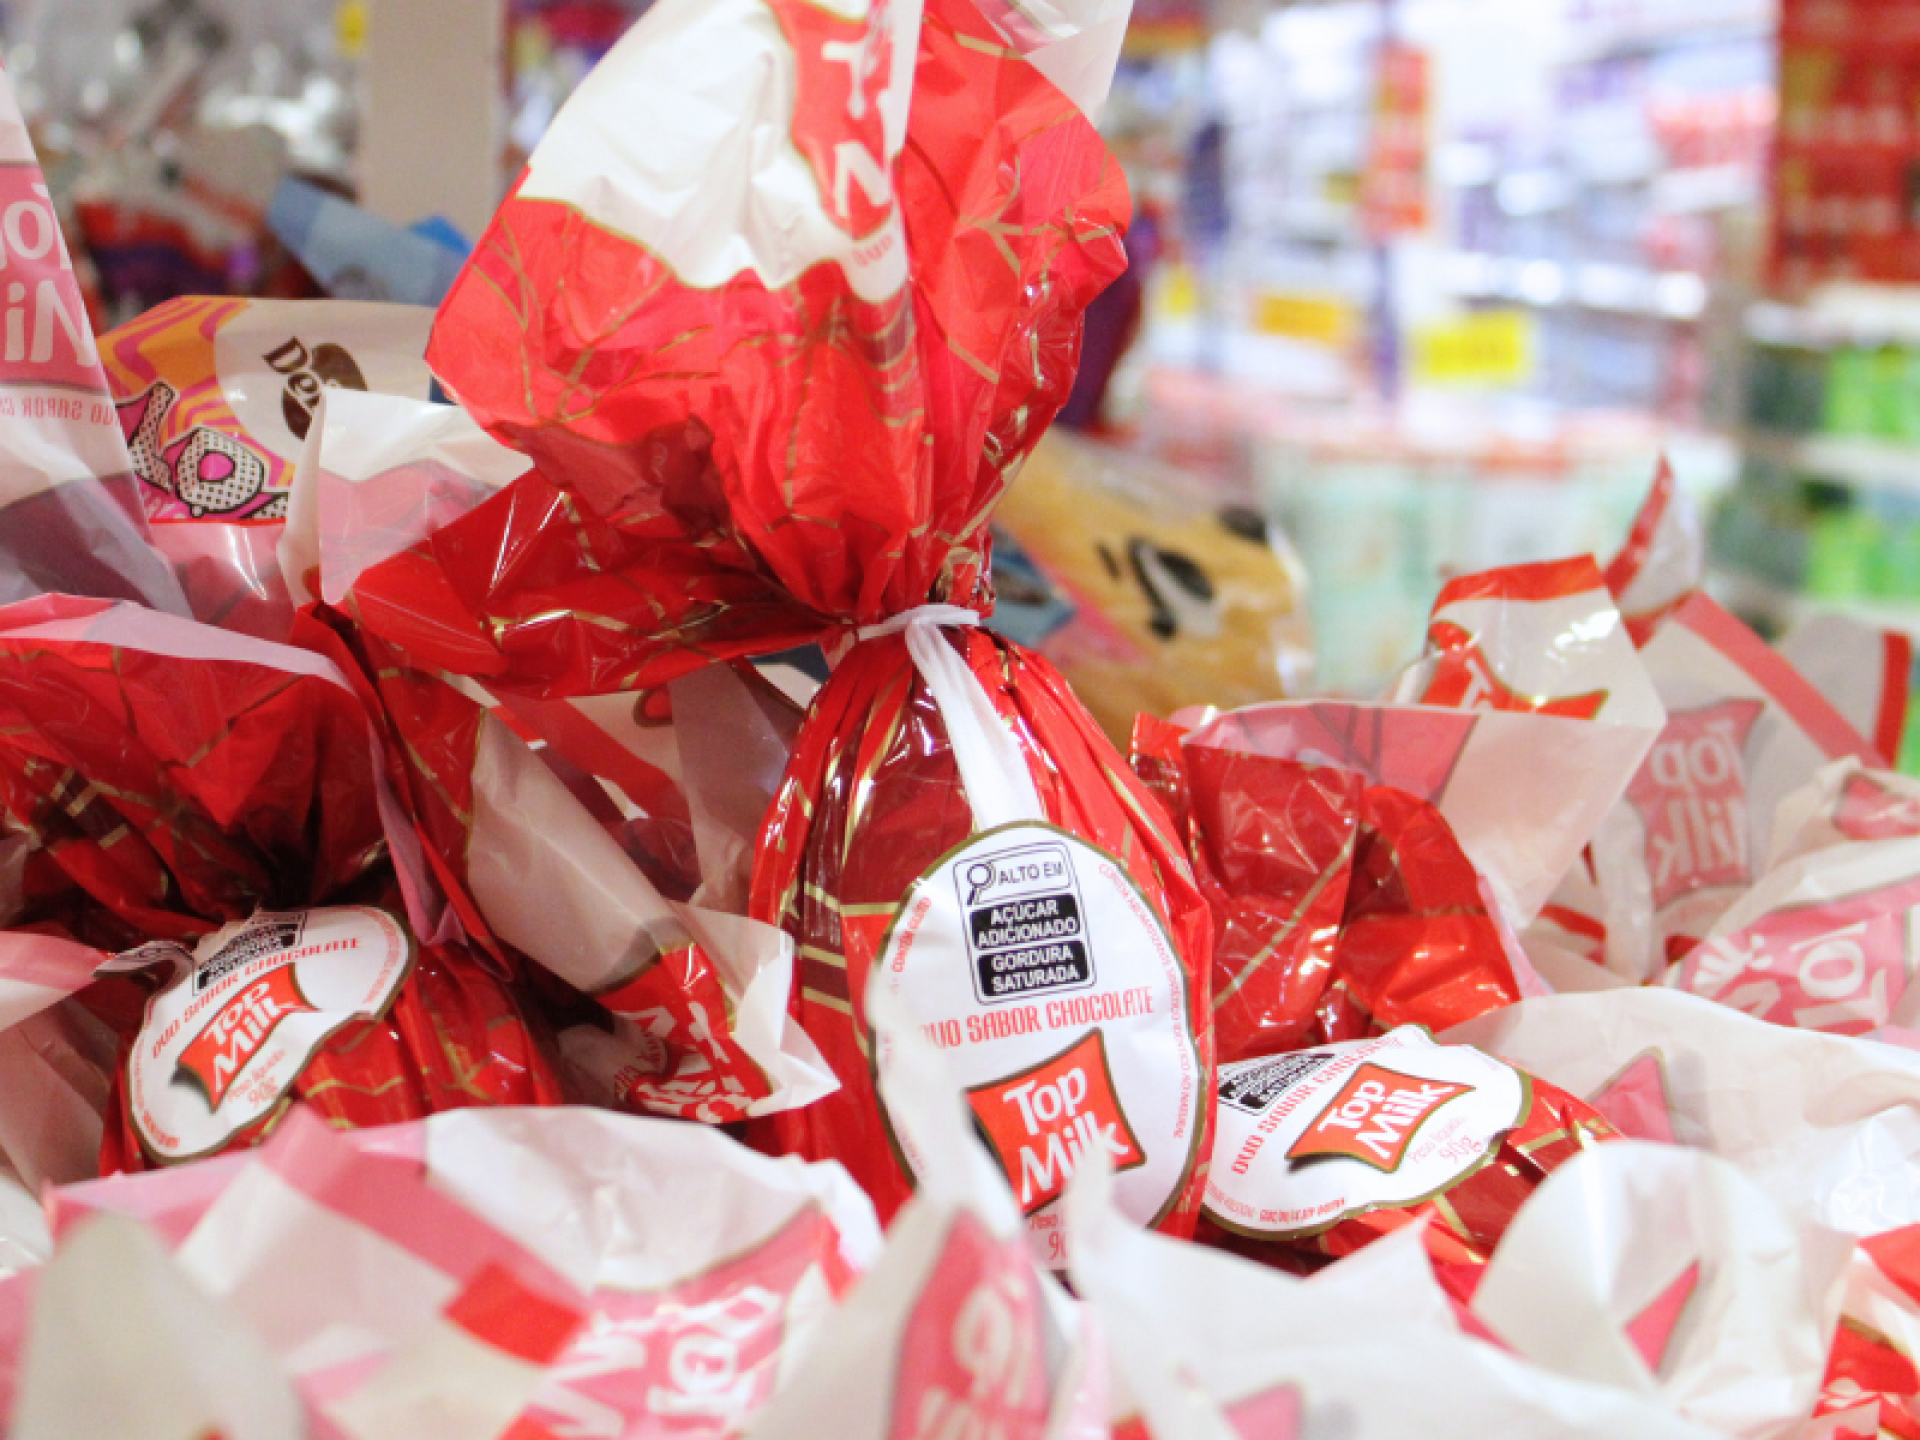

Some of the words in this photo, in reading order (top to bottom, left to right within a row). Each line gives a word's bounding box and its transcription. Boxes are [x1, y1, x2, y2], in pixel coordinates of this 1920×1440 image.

[999, 863, 1040, 887] ALTO
[978, 916, 1076, 948] ADICIONADO
[991, 944, 1074, 973] GORDURA
[991, 964, 1081, 992] SATURADA
[966, 1005, 1042, 1043] SABOR
[1046, 985, 1155, 1030] CHOCOLATE
[1002, 1067, 1088, 1136] Top
[1231, 1134, 1266, 1175] DUO
[1259, 1082, 1318, 1133] SABOR
[1317, 1079, 1386, 1133] Top
[1355, 1082, 1459, 1160] Milk
